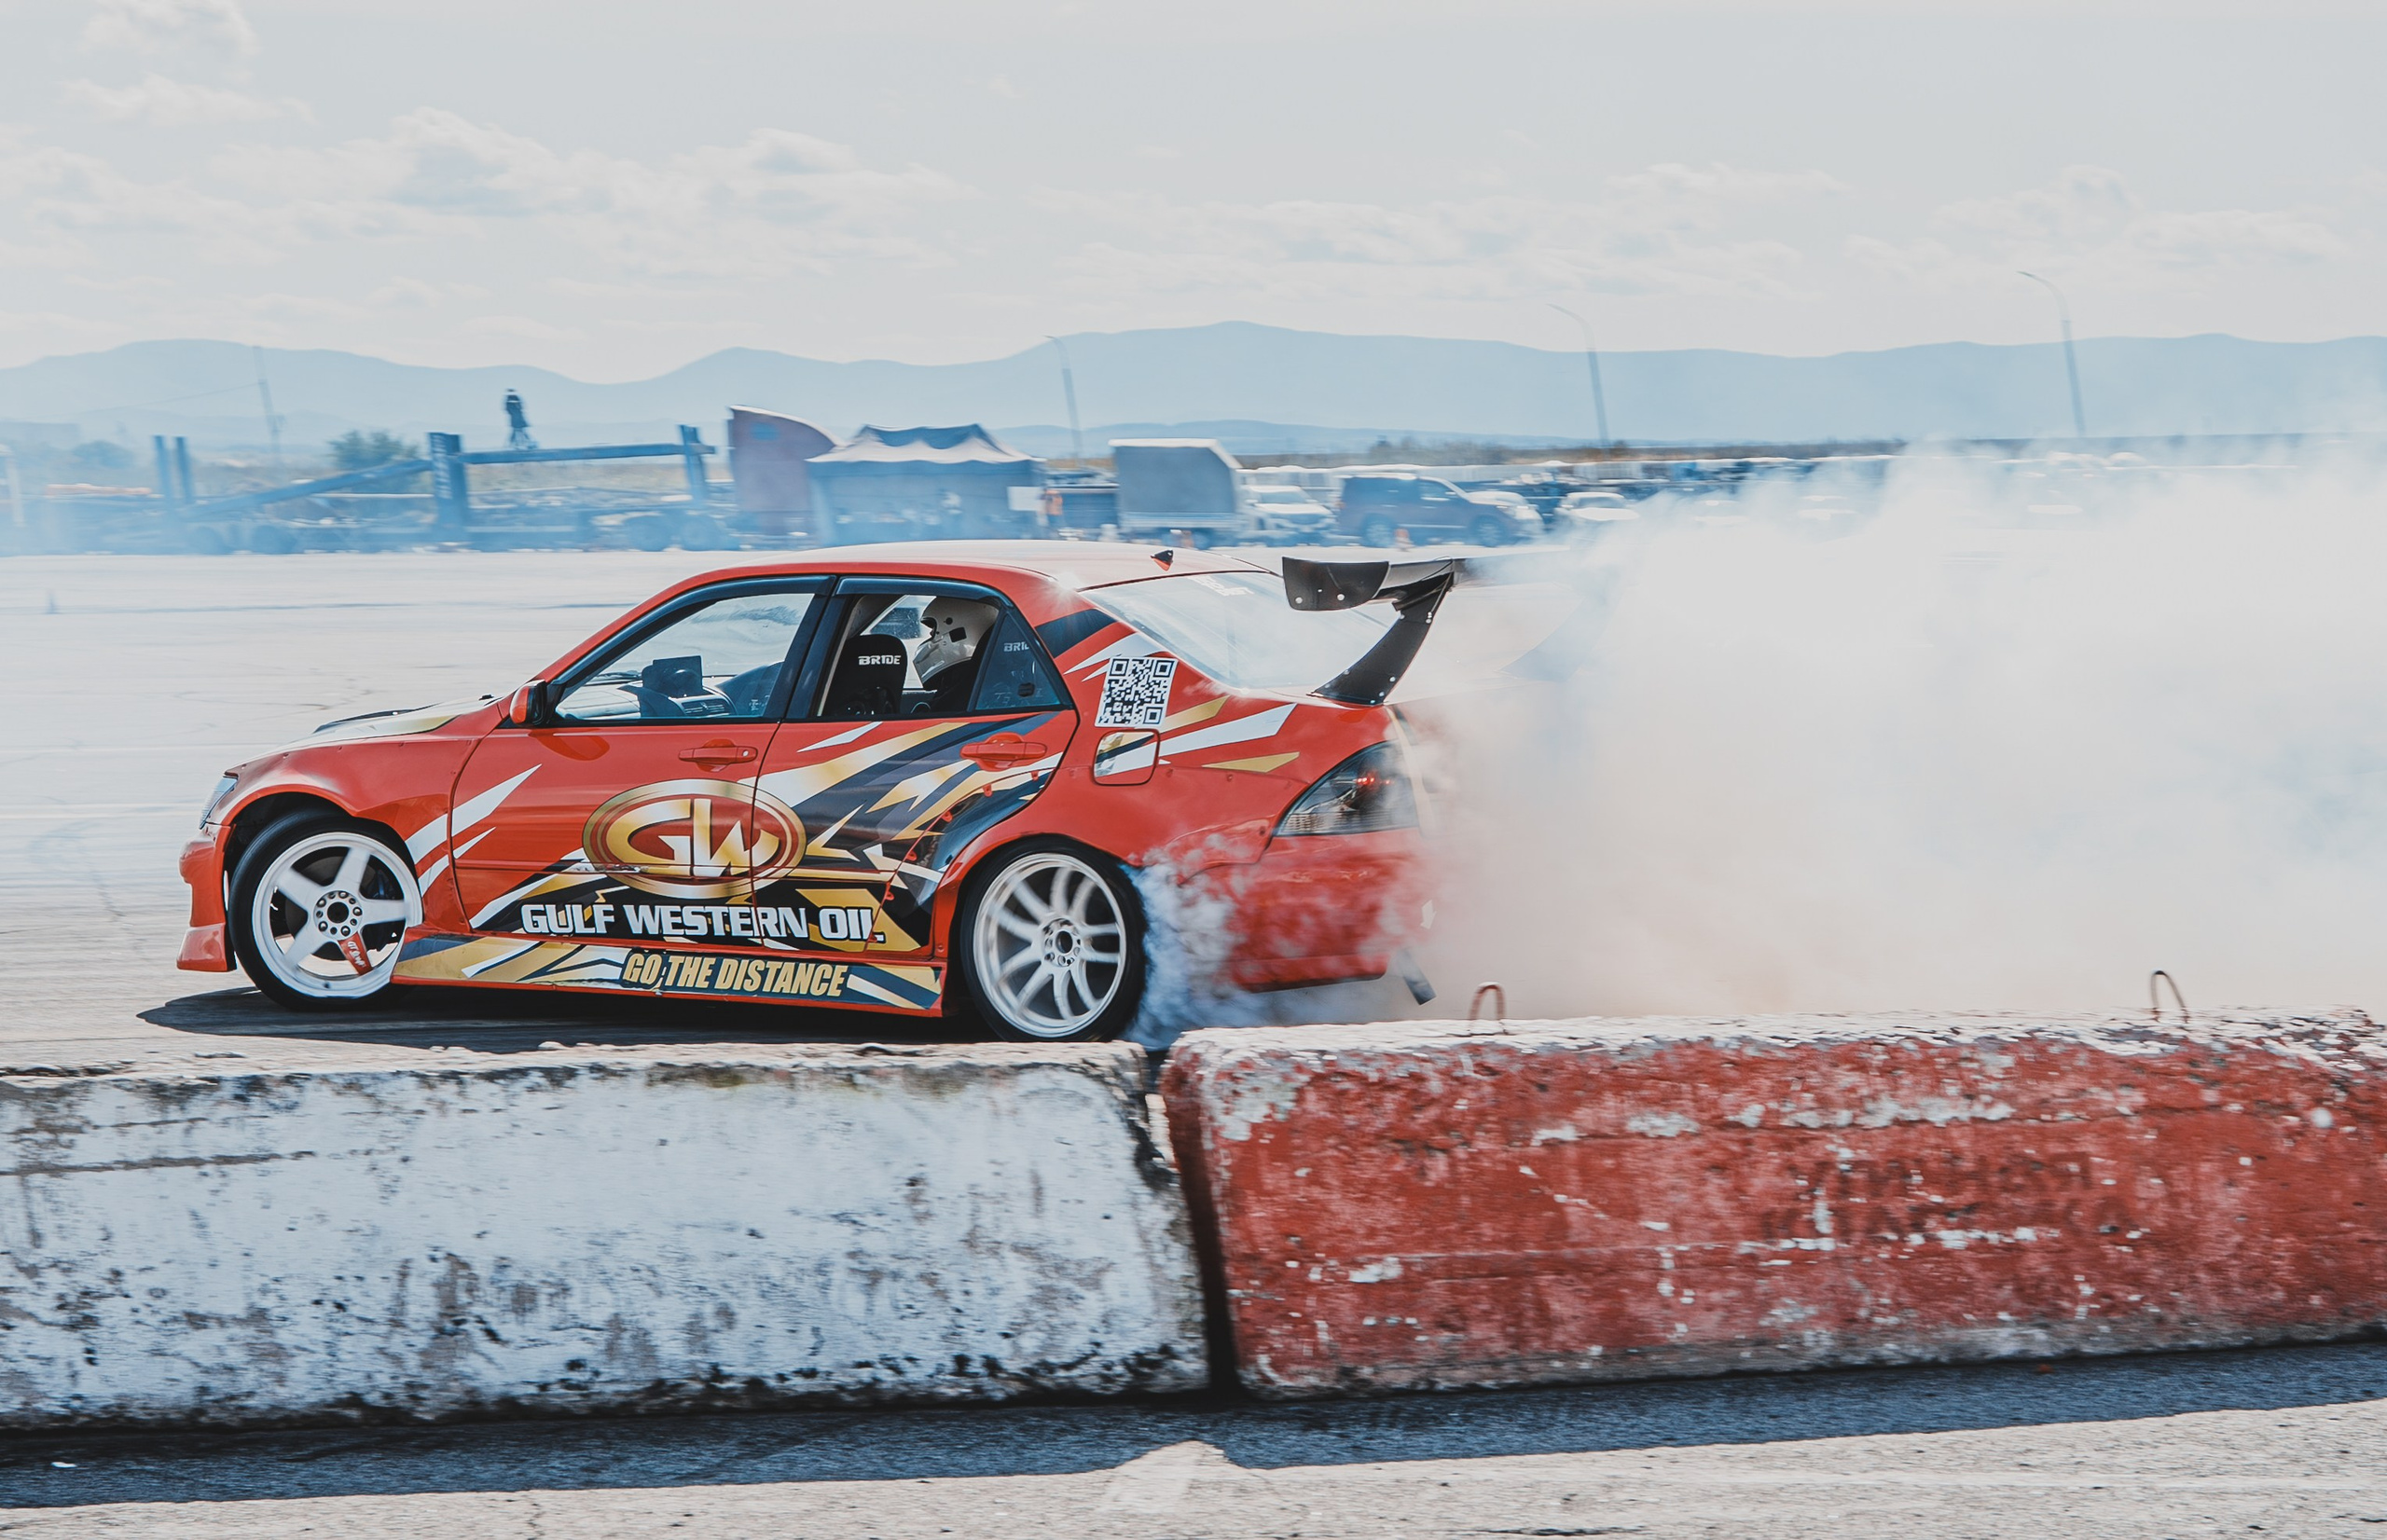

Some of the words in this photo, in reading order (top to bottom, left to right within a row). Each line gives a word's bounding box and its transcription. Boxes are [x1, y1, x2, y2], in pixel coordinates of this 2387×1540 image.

[858, 654, 902, 666] BRIDE
[606, 798, 780, 878] GW
[521, 903, 616, 935] GULF
[623, 904, 809, 940] WESTERN
[818, 908, 886, 942] OIL
[623, 953, 663, 985] GO
[664, 955, 716, 990] THE
[714, 958, 849, 997] DISTANCE
